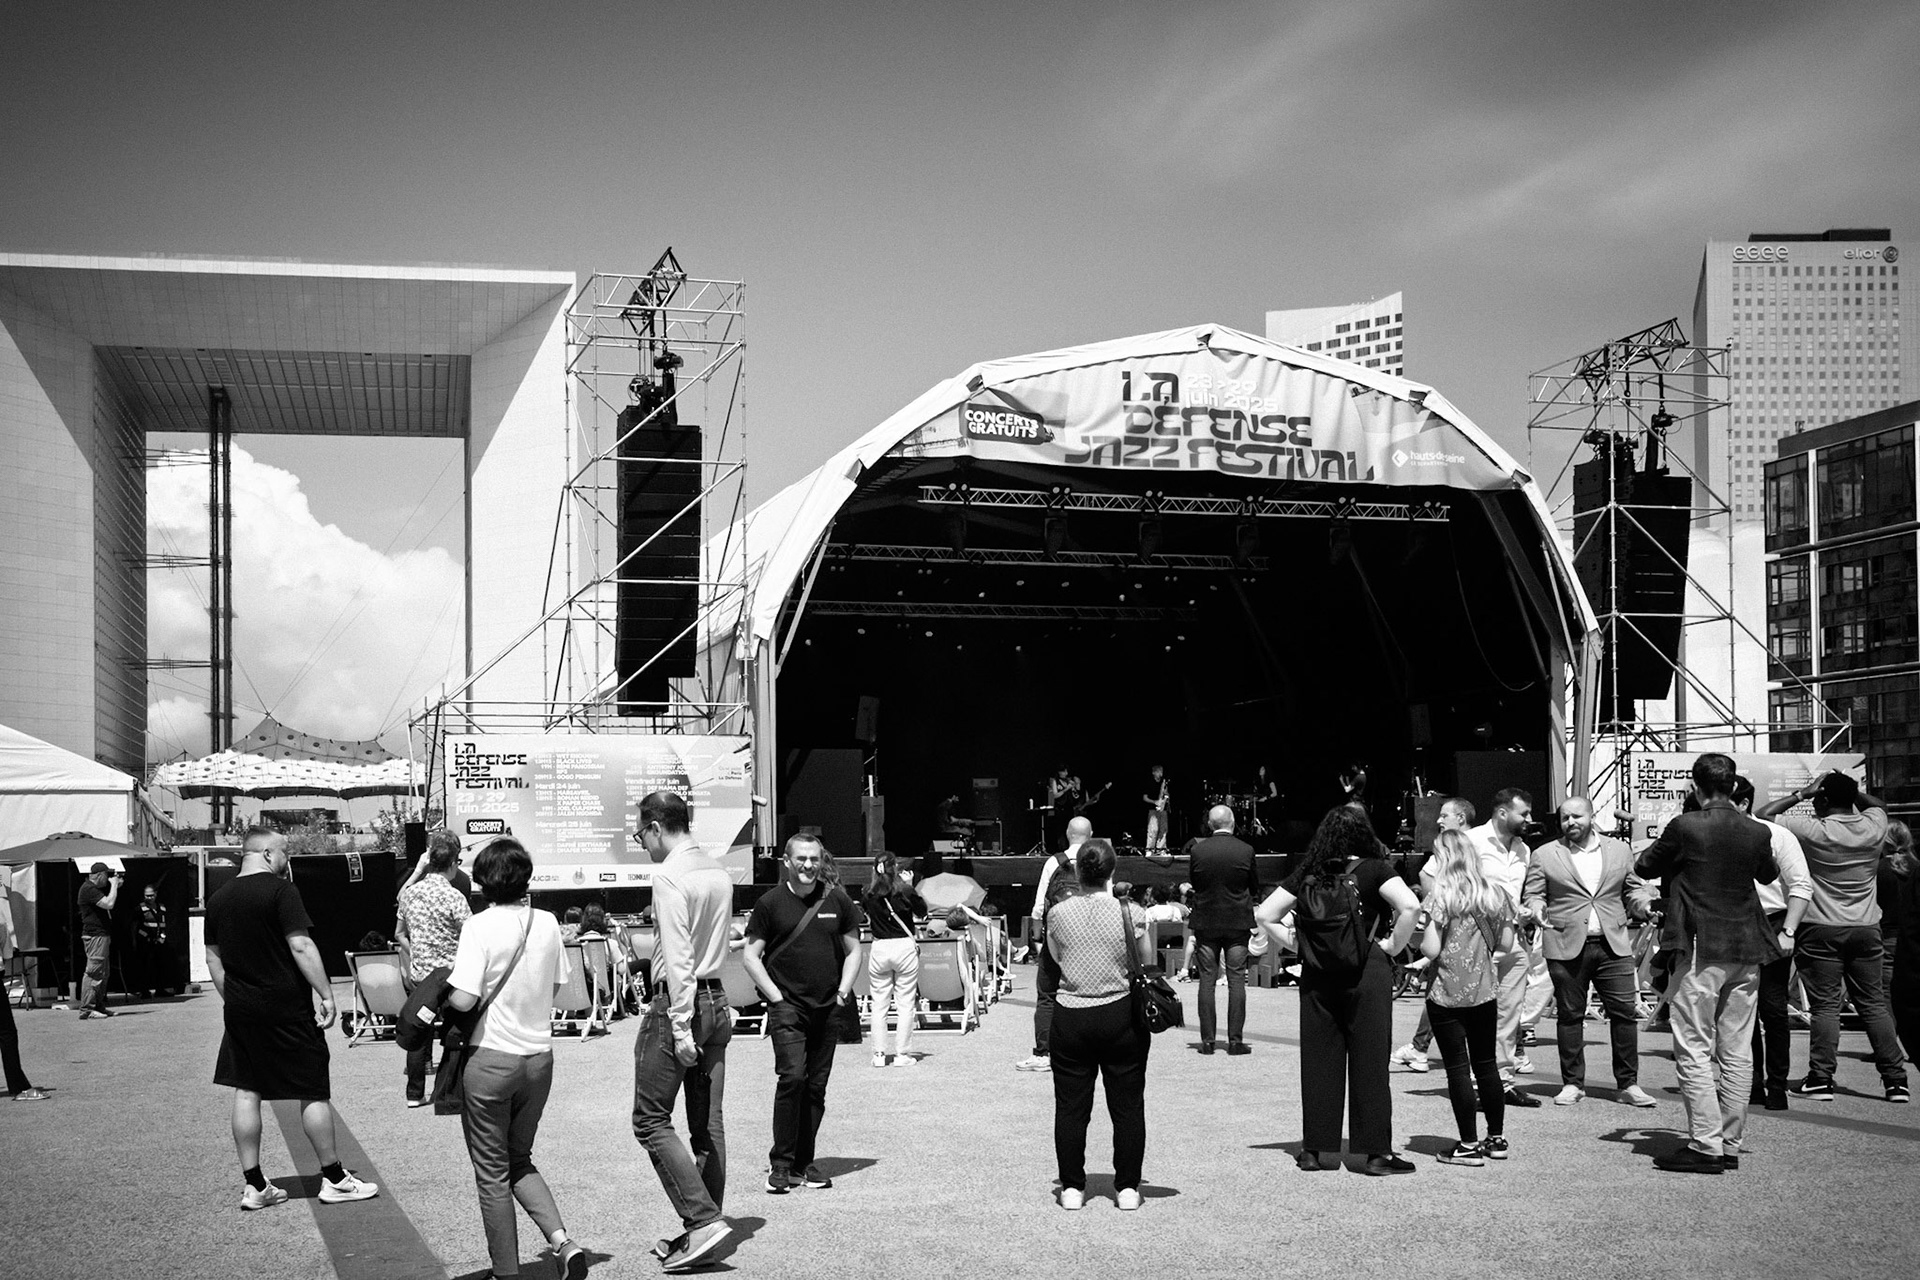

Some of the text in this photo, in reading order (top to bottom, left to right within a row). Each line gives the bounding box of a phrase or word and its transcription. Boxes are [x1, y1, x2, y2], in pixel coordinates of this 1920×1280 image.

[1844, 247, 1880, 260] elior
[1122, 371, 1179, 402] LA
[1187, 374, 1212, 389] 23
[1228, 379, 1257, 395] 29
[1185, 389, 1278, 412] juin 2025
[964, 409, 1039, 429] CONCERTS
[968, 421, 1037, 438] GRATUITS
[1065, 436, 1374, 481] JAZZ FESTIVAL
[455, 743, 476, 753] LA
[1638, 759, 1654, 769] LA
[450, 766, 490, 777] JAZZ
[455, 778, 529, 789] FESTIVAL
[1634, 780, 1665, 789] JAZZ
[456, 792, 474, 802] 23
[486, 792, 505, 802] 29
[456, 802, 519, 815] juin 2025
[1638, 813, 1656, 822] juin
